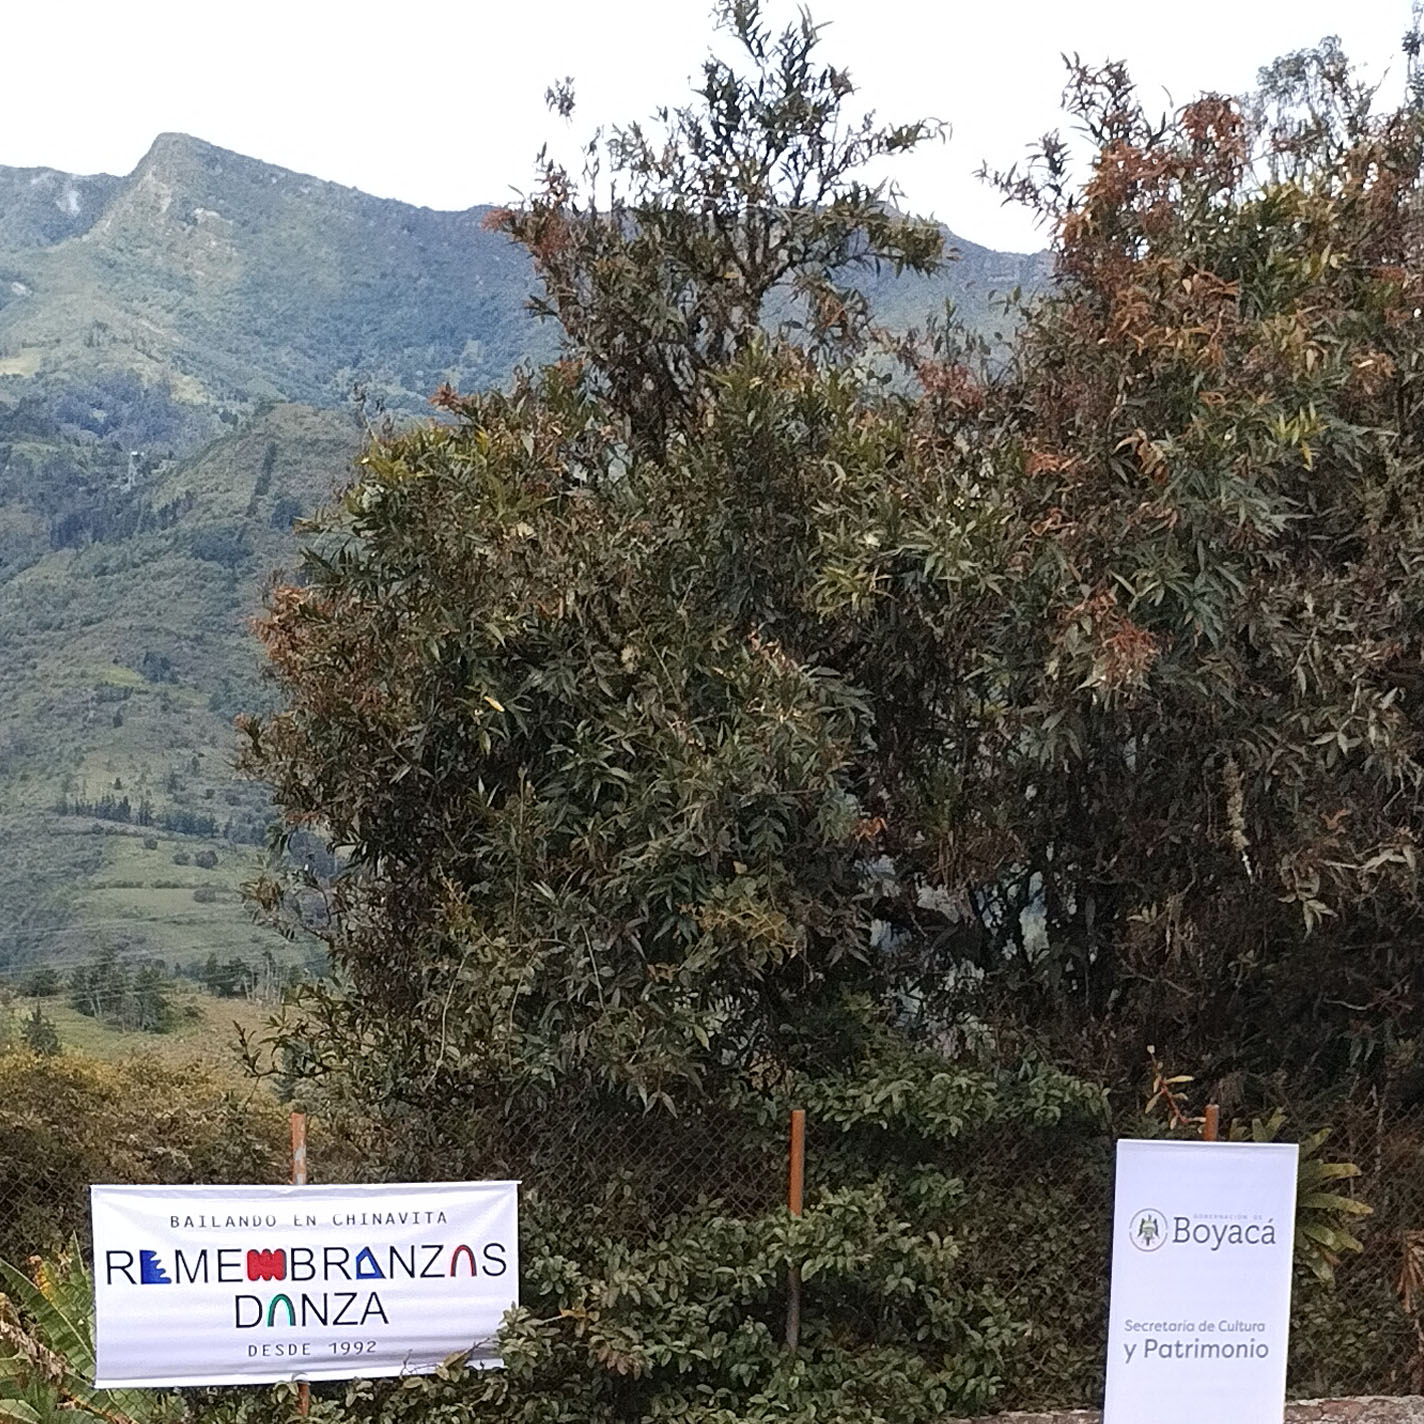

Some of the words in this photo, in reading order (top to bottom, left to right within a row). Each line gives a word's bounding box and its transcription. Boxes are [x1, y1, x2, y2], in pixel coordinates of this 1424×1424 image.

[170, 1213, 276, 1229] BAILANDO
[294, 1213, 317, 1227] EN
[332, 1211, 447, 1226] CHINAVITA
[1172, 1216, 1276, 1251] Boyacá
[235, 1292, 389, 1329] DANZA
[1198, 1320, 1215, 1332] de
[1218, 1320, 1266, 1333] Cultura
[248, 1342, 311, 1357] DESDE
[328, 1340, 377, 1355] 1992
[1123, 1343, 1137, 1365] y
[1144, 1338, 1269, 1359] Patrimonio
